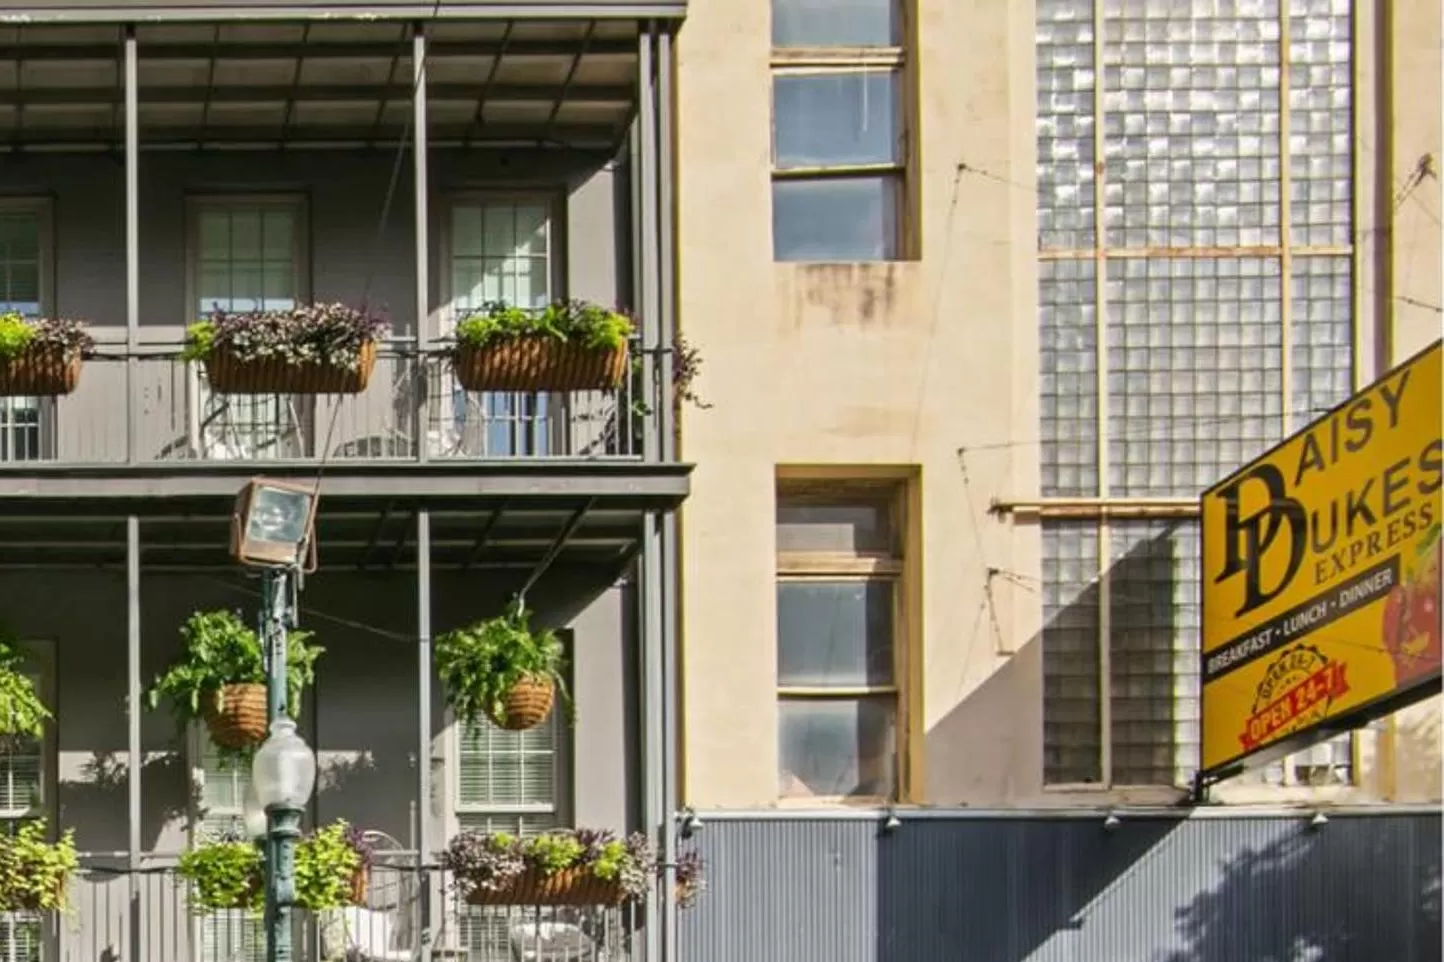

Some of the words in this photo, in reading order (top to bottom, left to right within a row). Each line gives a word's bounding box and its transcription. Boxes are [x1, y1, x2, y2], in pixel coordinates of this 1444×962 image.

[1313, 503, 1434, 586] EXPRESS
[1206, 627, 1274, 675] BREAKFAST
[1283, 601, 1328, 638] LUNCH
[1338, 567, 1394, 609] DINNER
[1249, 694, 1292, 742] OPEN
